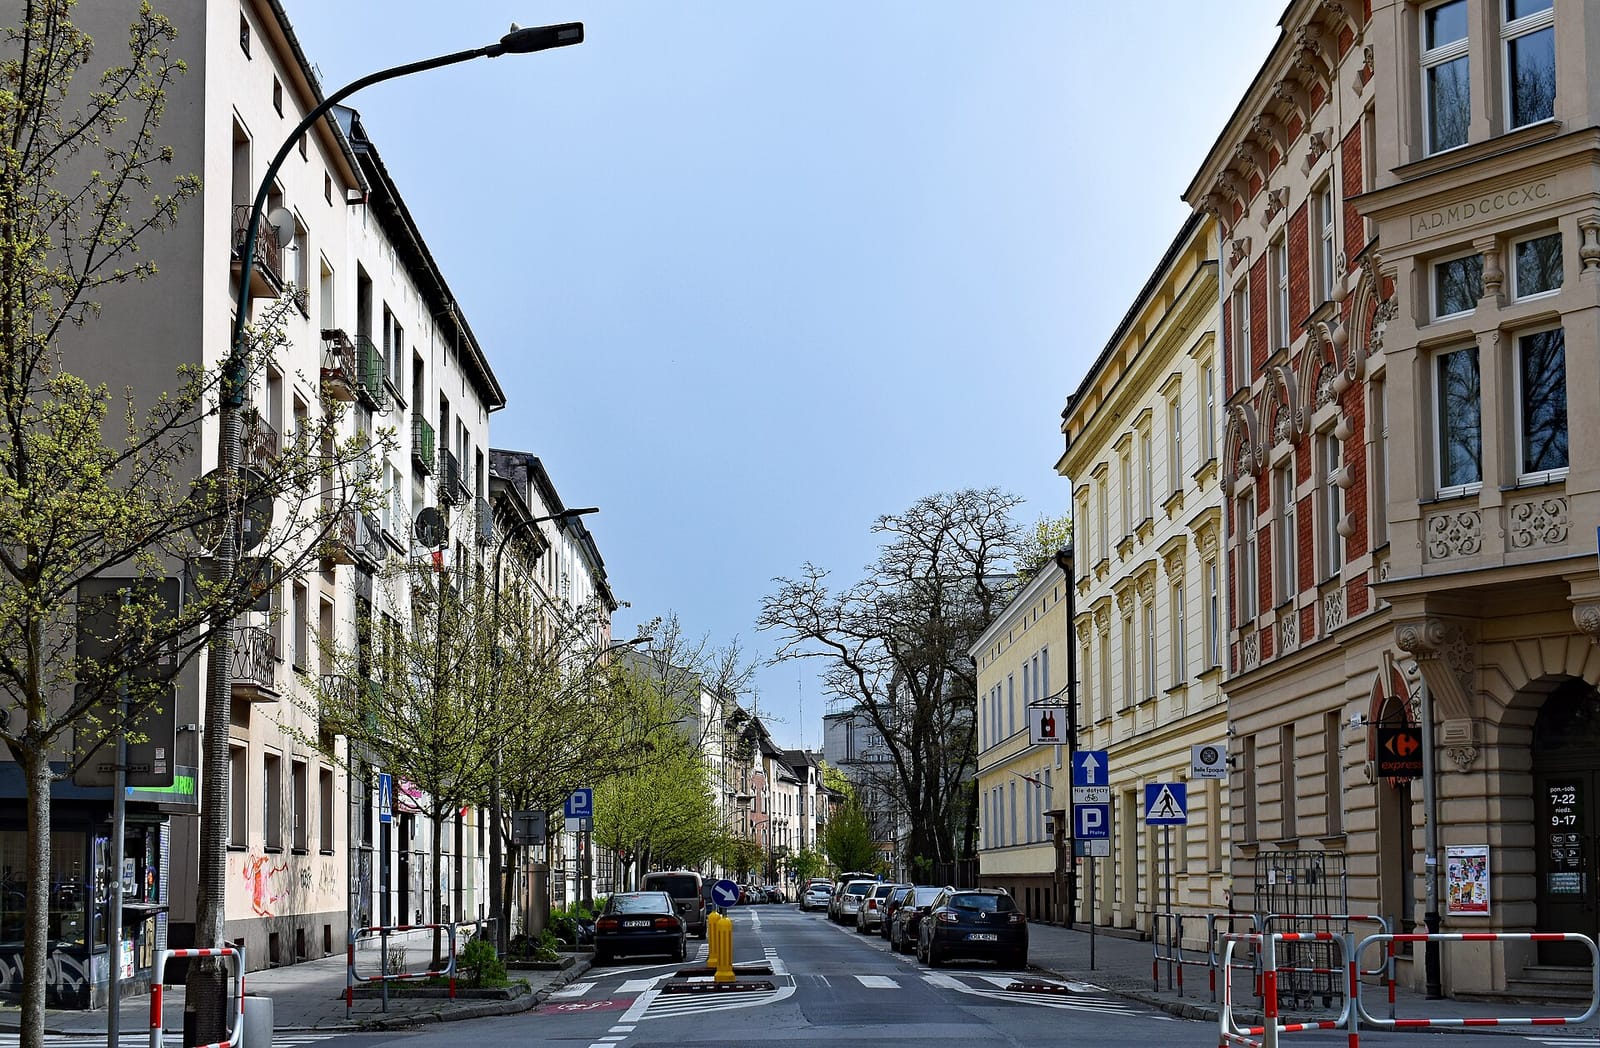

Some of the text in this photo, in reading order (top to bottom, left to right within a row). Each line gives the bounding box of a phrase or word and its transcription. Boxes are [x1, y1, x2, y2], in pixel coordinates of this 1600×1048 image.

[1381, 761, 1423, 771] express
[1086, 787, 1108, 795] dotyczy
[570, 791, 587, 815] P
[1551, 793, 1576, 805] 7-22
[1082, 808, 1102, 835] P
[1551, 815, 1577, 826] 9-17
